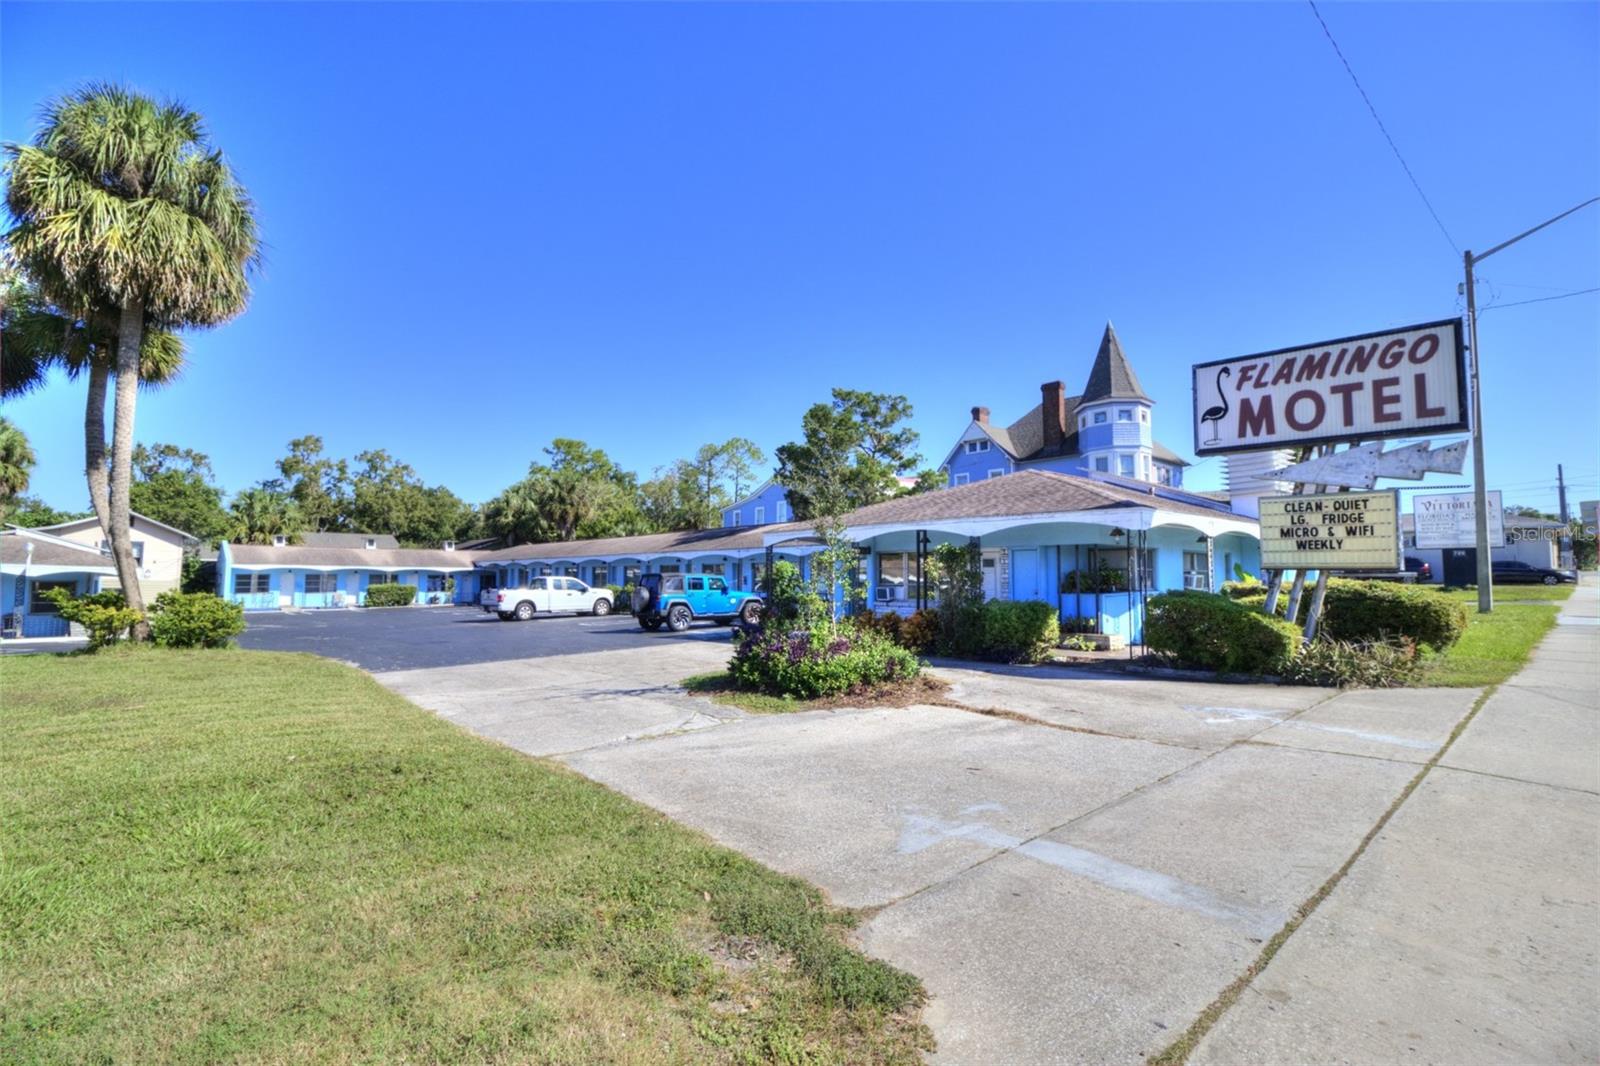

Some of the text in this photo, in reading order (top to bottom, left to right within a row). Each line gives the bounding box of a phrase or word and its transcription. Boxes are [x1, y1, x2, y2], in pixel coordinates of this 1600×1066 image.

[1236, 333, 1440, 391] FLAMINGO
[1238, 373, 1446, 439] MOTEL
[1291, 512, 1365, 525] LG. FRIDGE
[1280, 525, 1374, 538] MICRO & WIFI
[1296, 539, 1343, 550] WEEKLY
